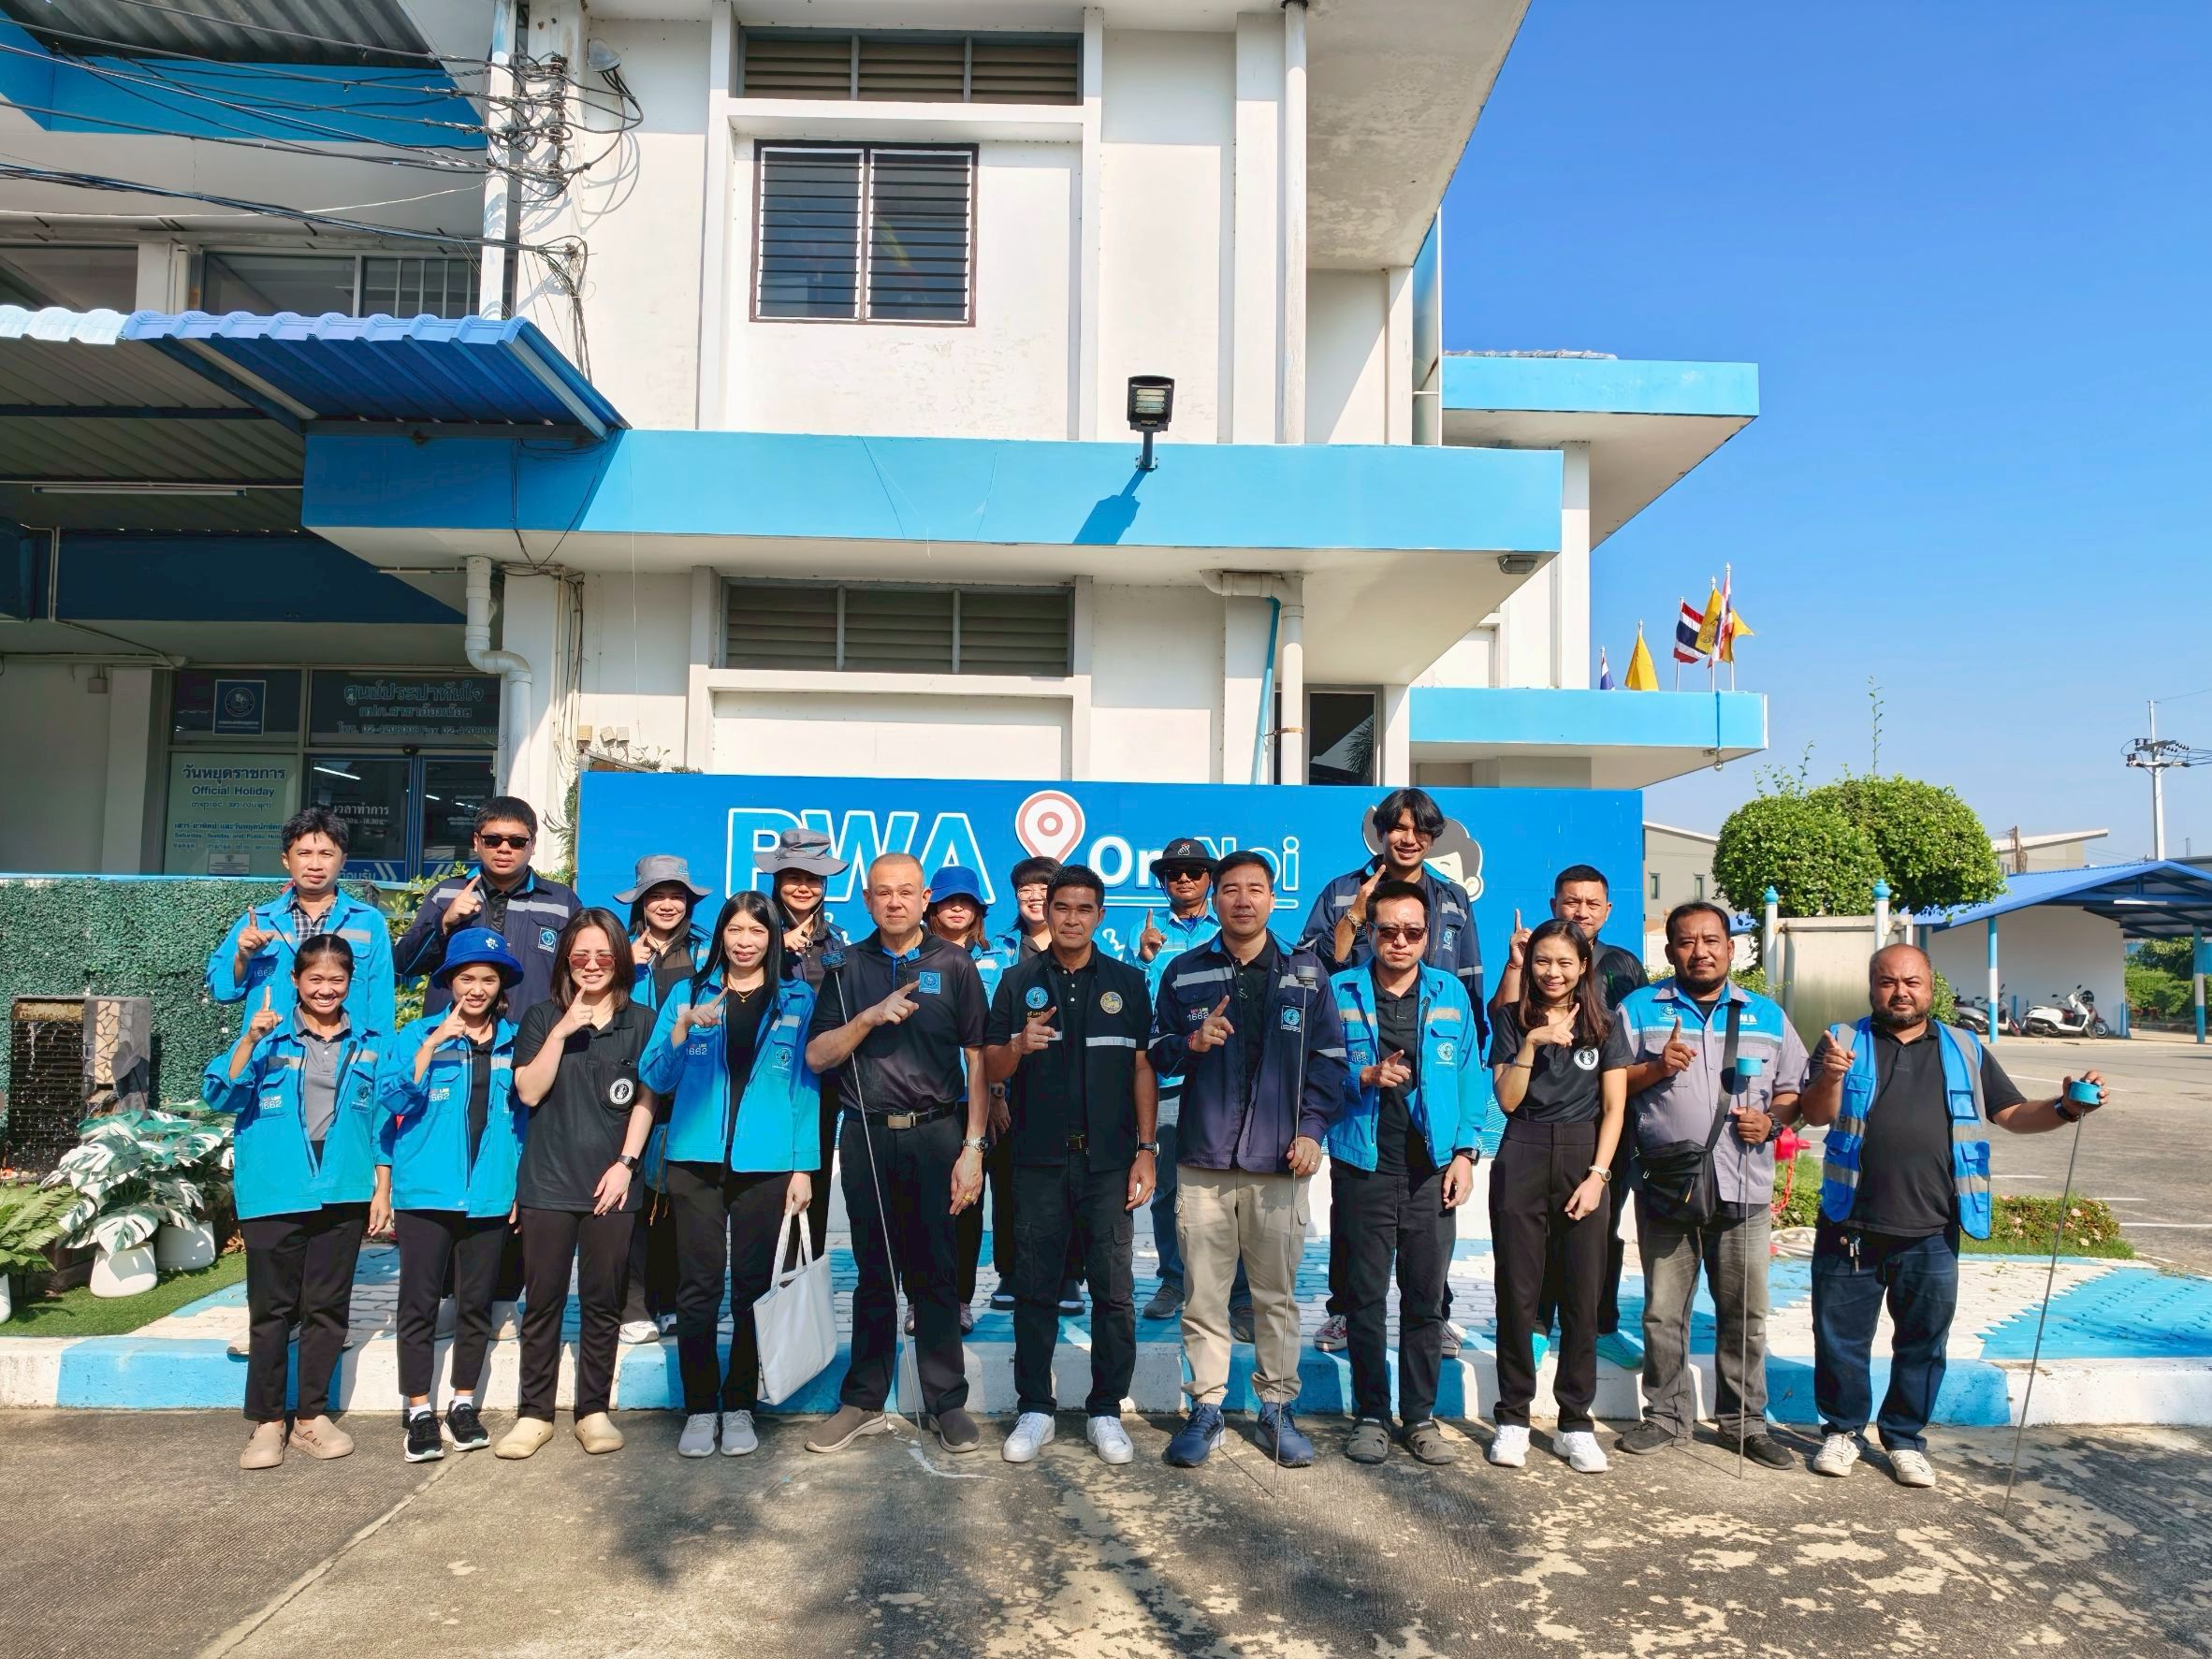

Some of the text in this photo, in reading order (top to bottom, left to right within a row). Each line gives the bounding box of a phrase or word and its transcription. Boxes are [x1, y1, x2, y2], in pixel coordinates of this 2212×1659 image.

[182, 764, 285, 784] วันหยุดราชการ
[192, 786, 275, 797] Official Holiday
[725, 808, 997, 905] PWA
[1186, 1011, 1210, 1022] 1662
[260, 1099, 282, 1111] 1662
